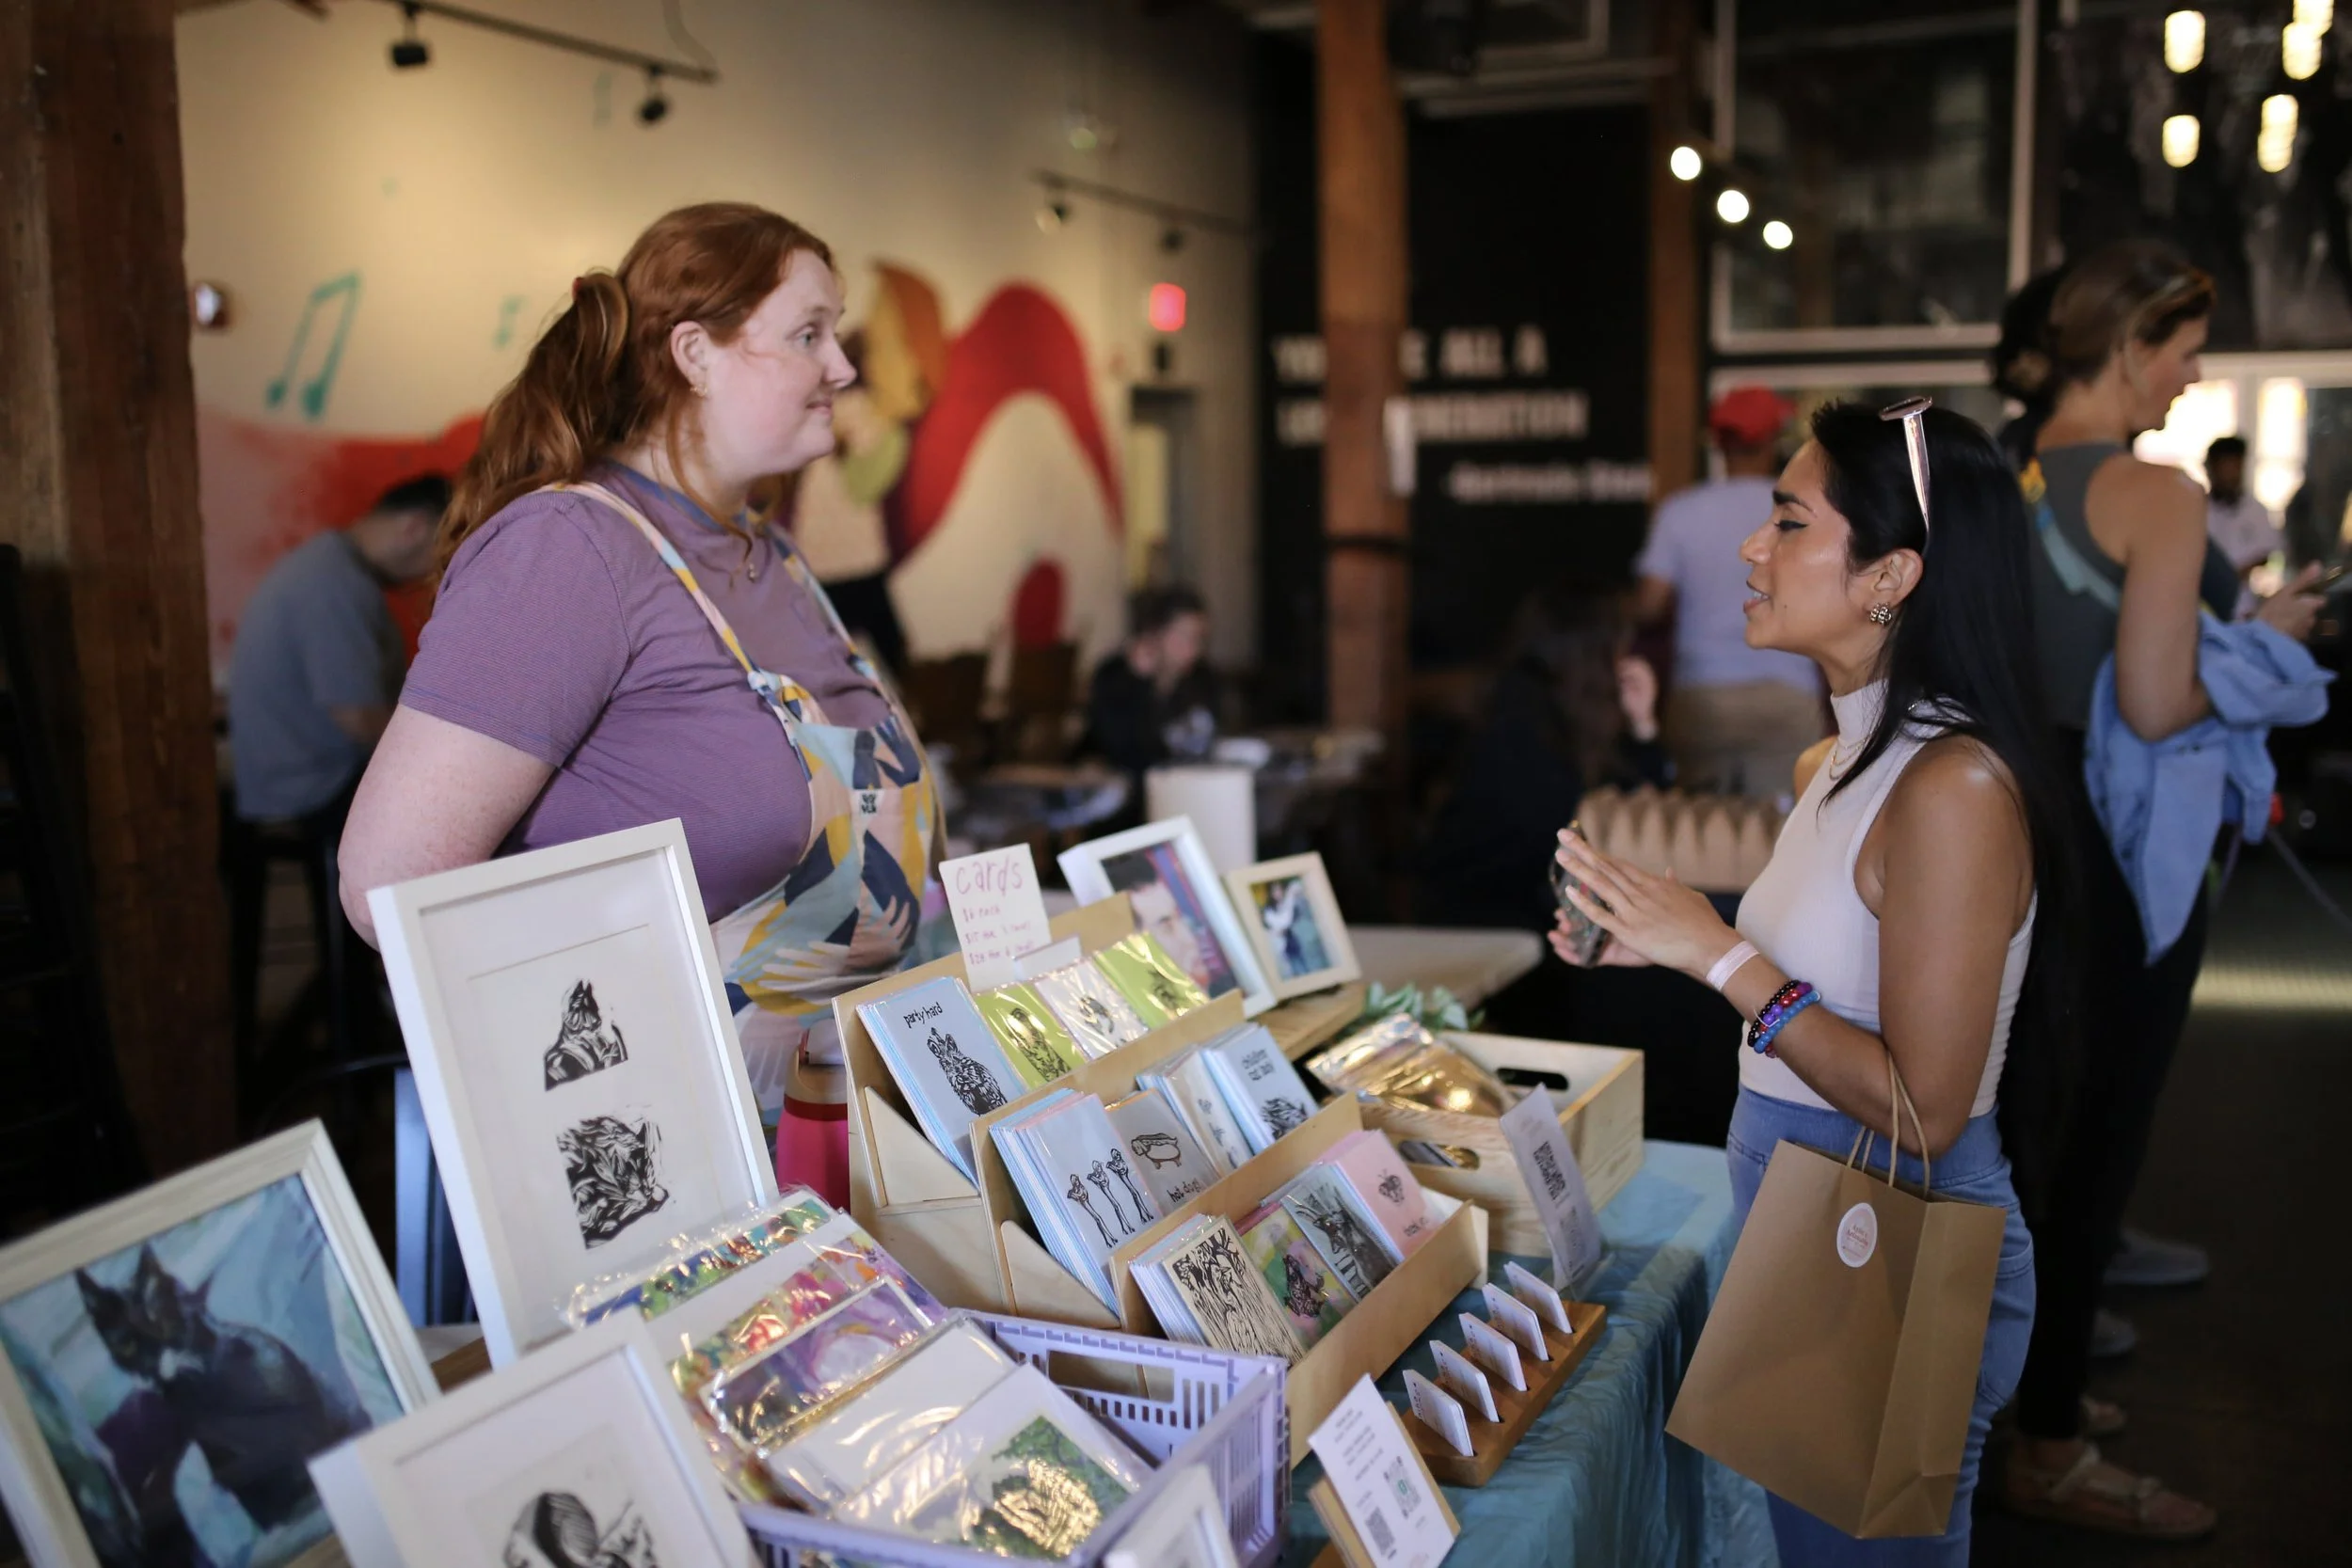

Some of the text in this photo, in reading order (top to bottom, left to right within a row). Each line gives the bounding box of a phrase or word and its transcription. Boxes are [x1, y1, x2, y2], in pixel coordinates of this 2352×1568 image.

[903, 1001, 944, 1029] party hard
[1167, 1185, 1184, 1203] hot
